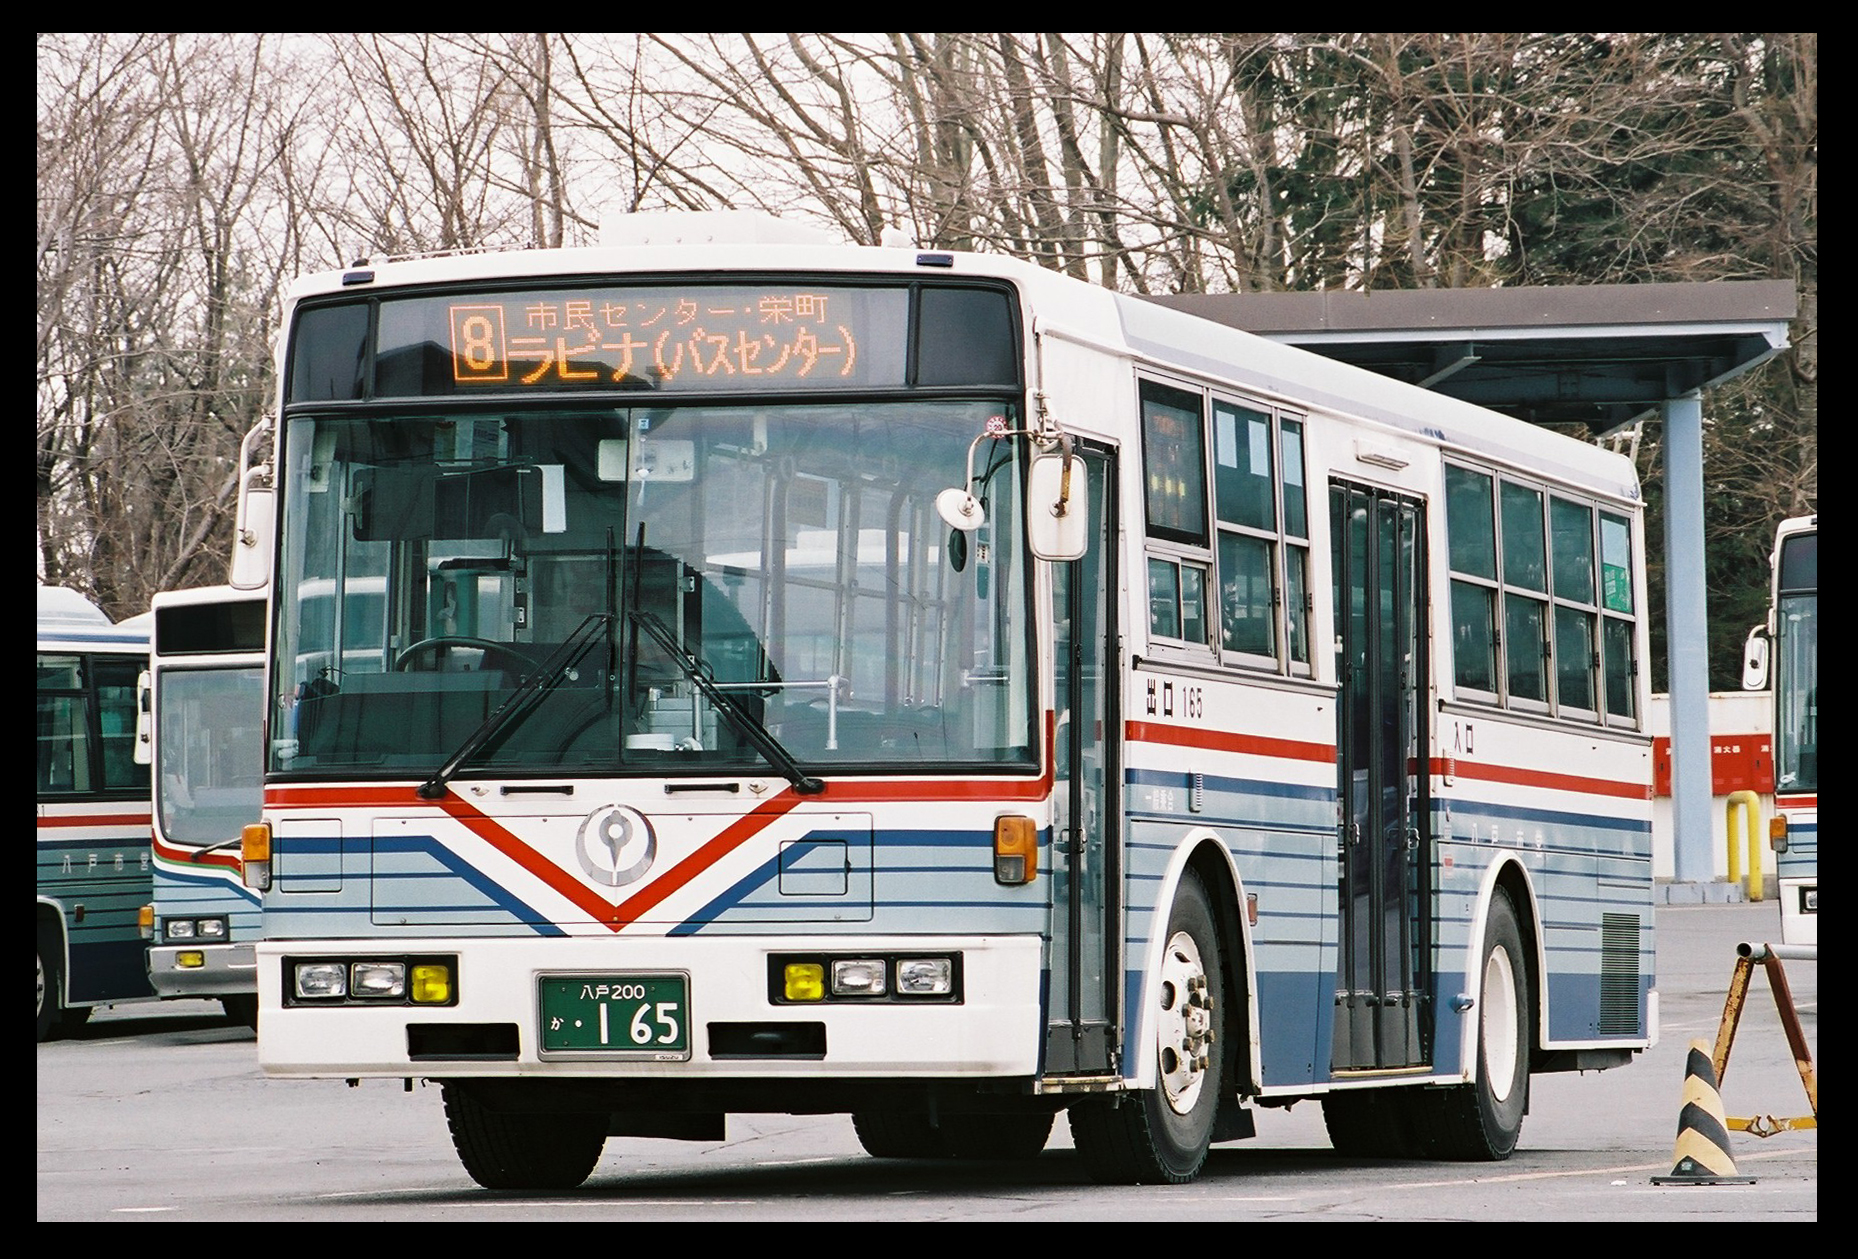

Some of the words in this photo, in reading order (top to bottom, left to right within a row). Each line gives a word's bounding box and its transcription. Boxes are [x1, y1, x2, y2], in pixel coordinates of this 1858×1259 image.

[526, 294, 828, 330] 市民センター・栄町
[462, 315, 495, 370] 8
[1147, 678, 1174, 717] 出口
[1182, 686, 1203, 719] 165
[1454, 721, 1474, 755] 入口
[580, 984, 645, 1000] 八戸200
[550, 1016, 565, 1031] か
